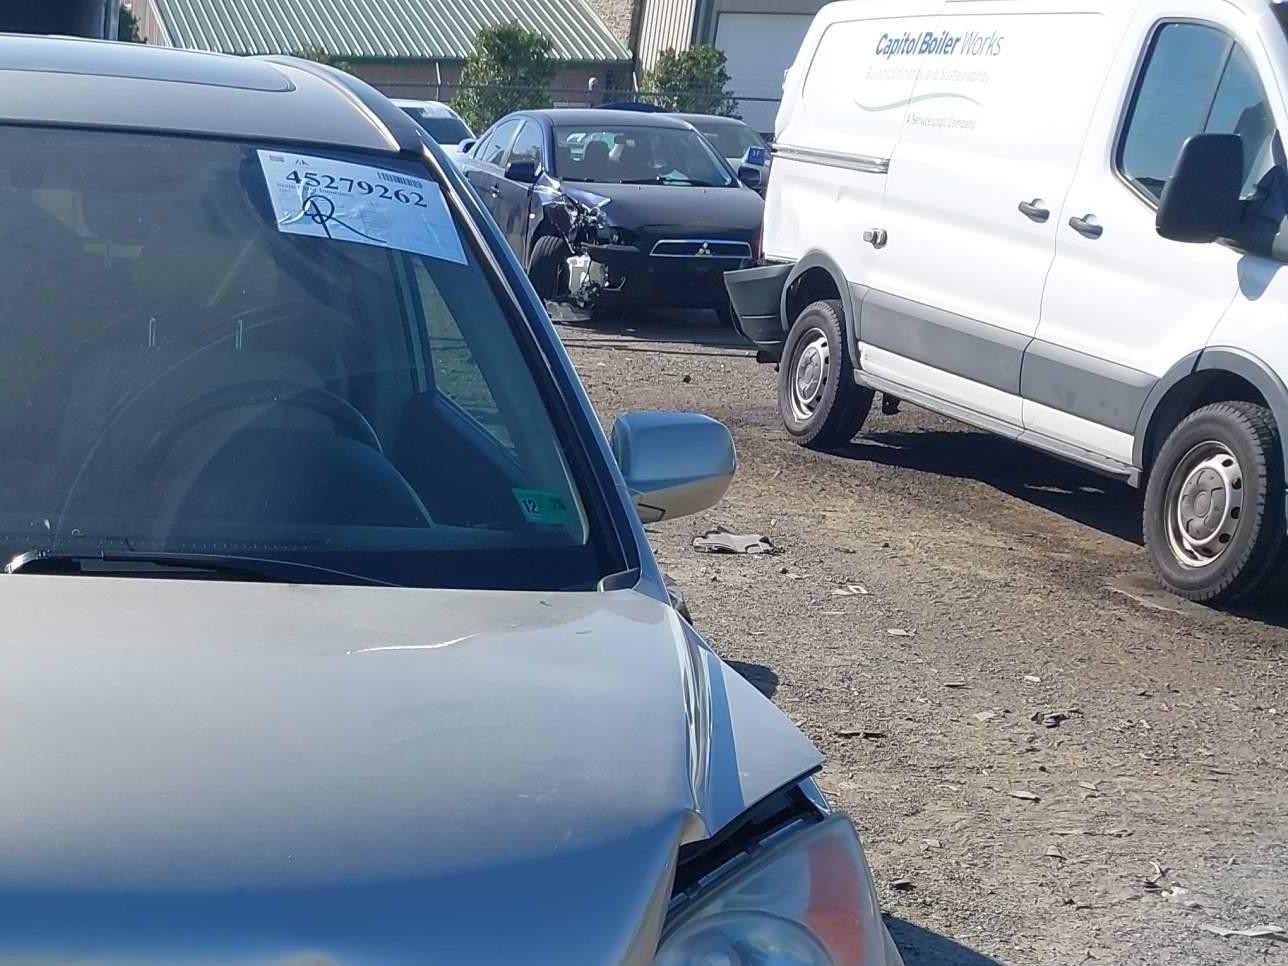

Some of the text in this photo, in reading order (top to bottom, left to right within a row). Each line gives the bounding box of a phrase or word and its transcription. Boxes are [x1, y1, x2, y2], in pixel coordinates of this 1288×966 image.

[875, 30, 1006, 60] Capitol Boiler Works
[285, 170, 428, 209] 45279262
